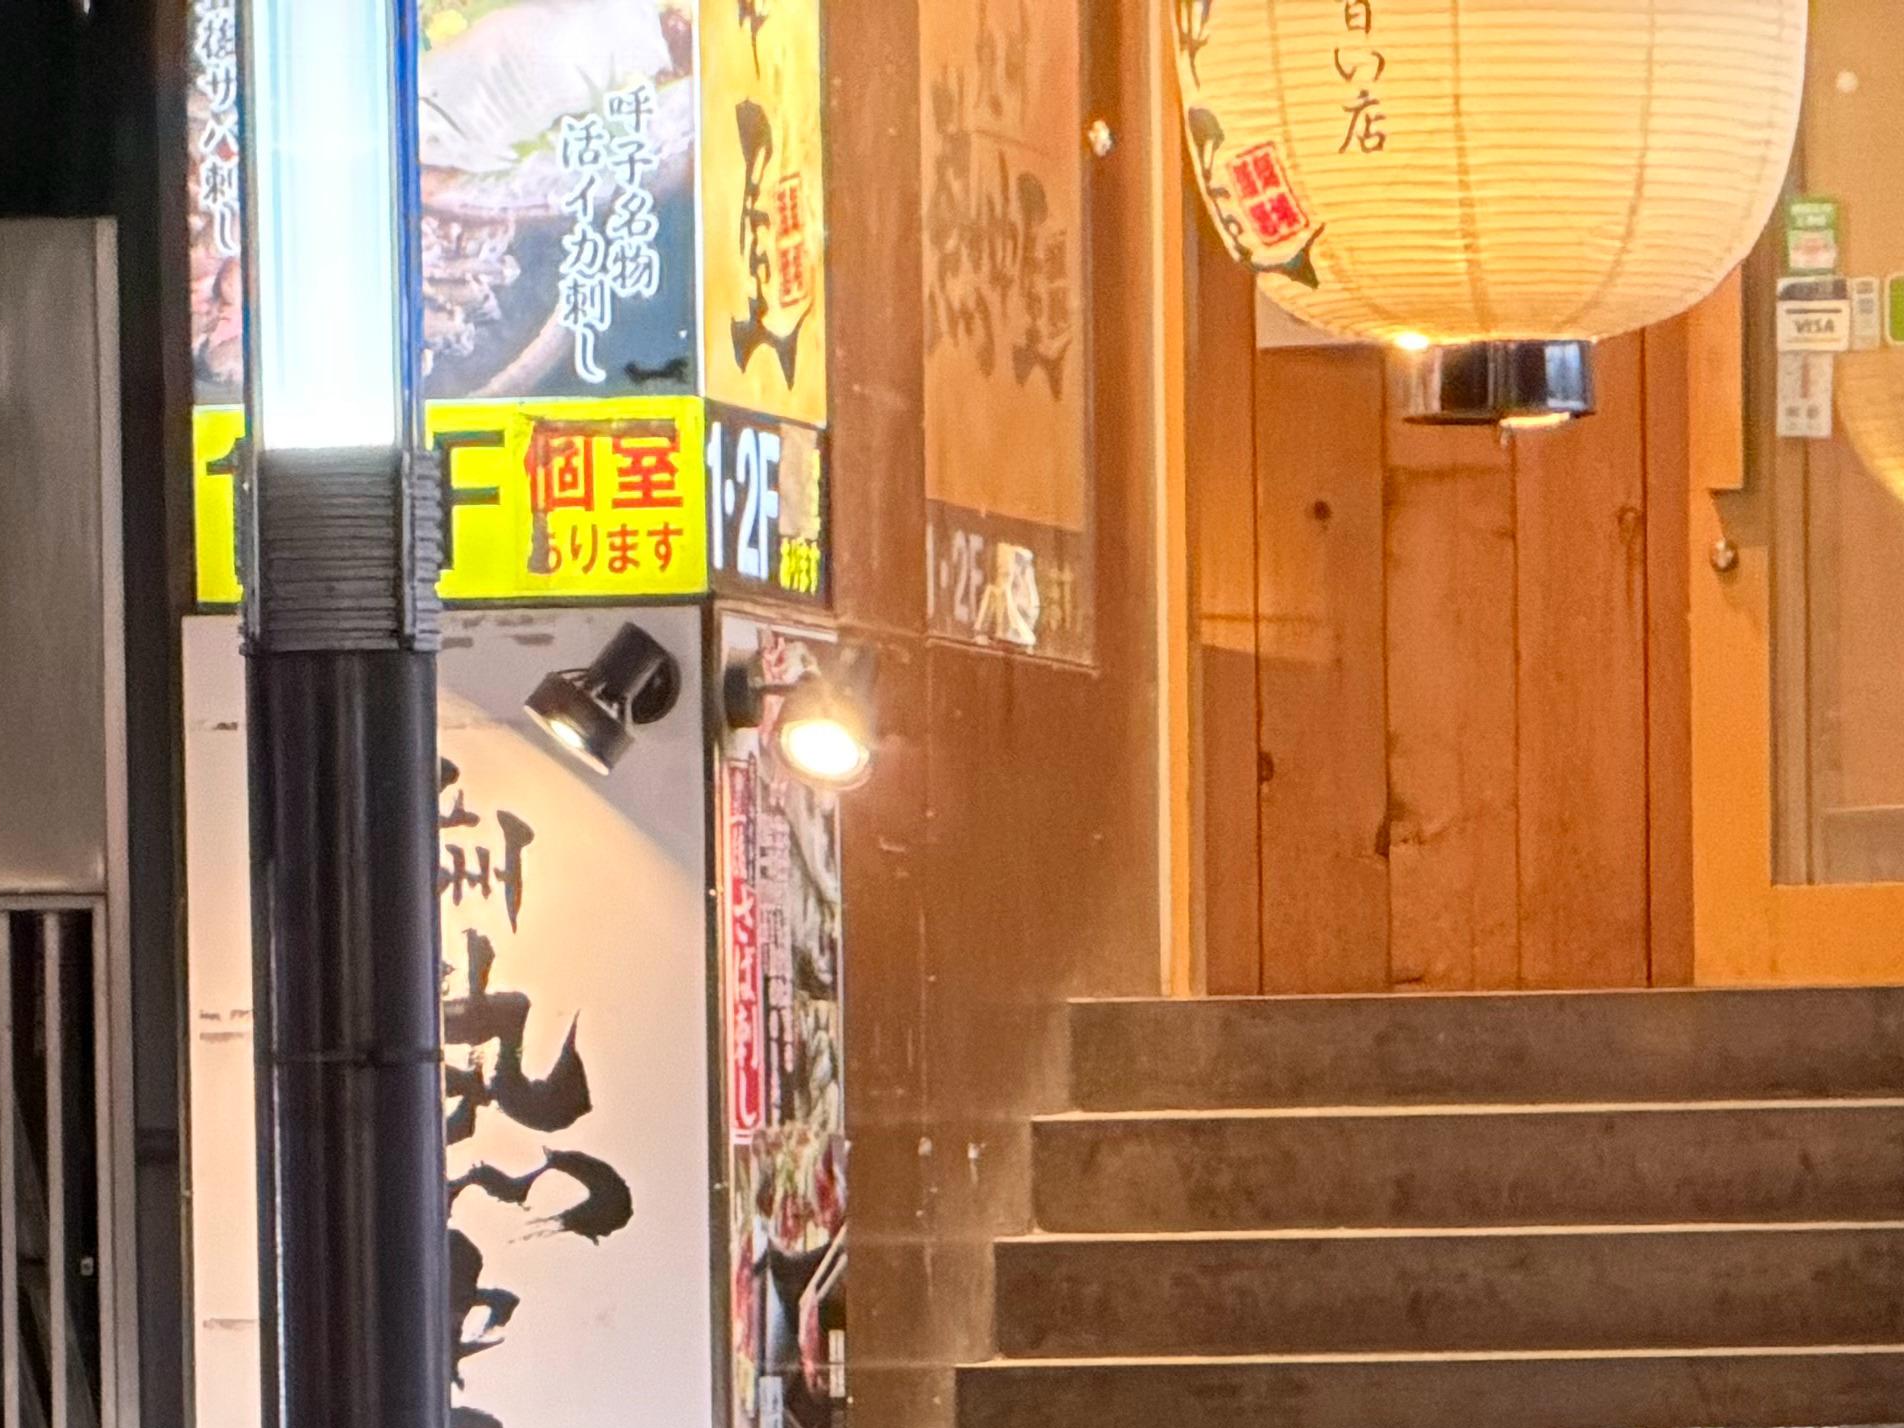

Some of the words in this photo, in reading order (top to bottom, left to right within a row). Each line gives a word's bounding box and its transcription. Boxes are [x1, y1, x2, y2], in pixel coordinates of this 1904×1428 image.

[556, 115, 612, 383] 活イカ刺し
[604, 84, 660, 298] 呼子名物
[1794, 318, 1836, 336] VISA
[524, 420, 684, 513] 個室
